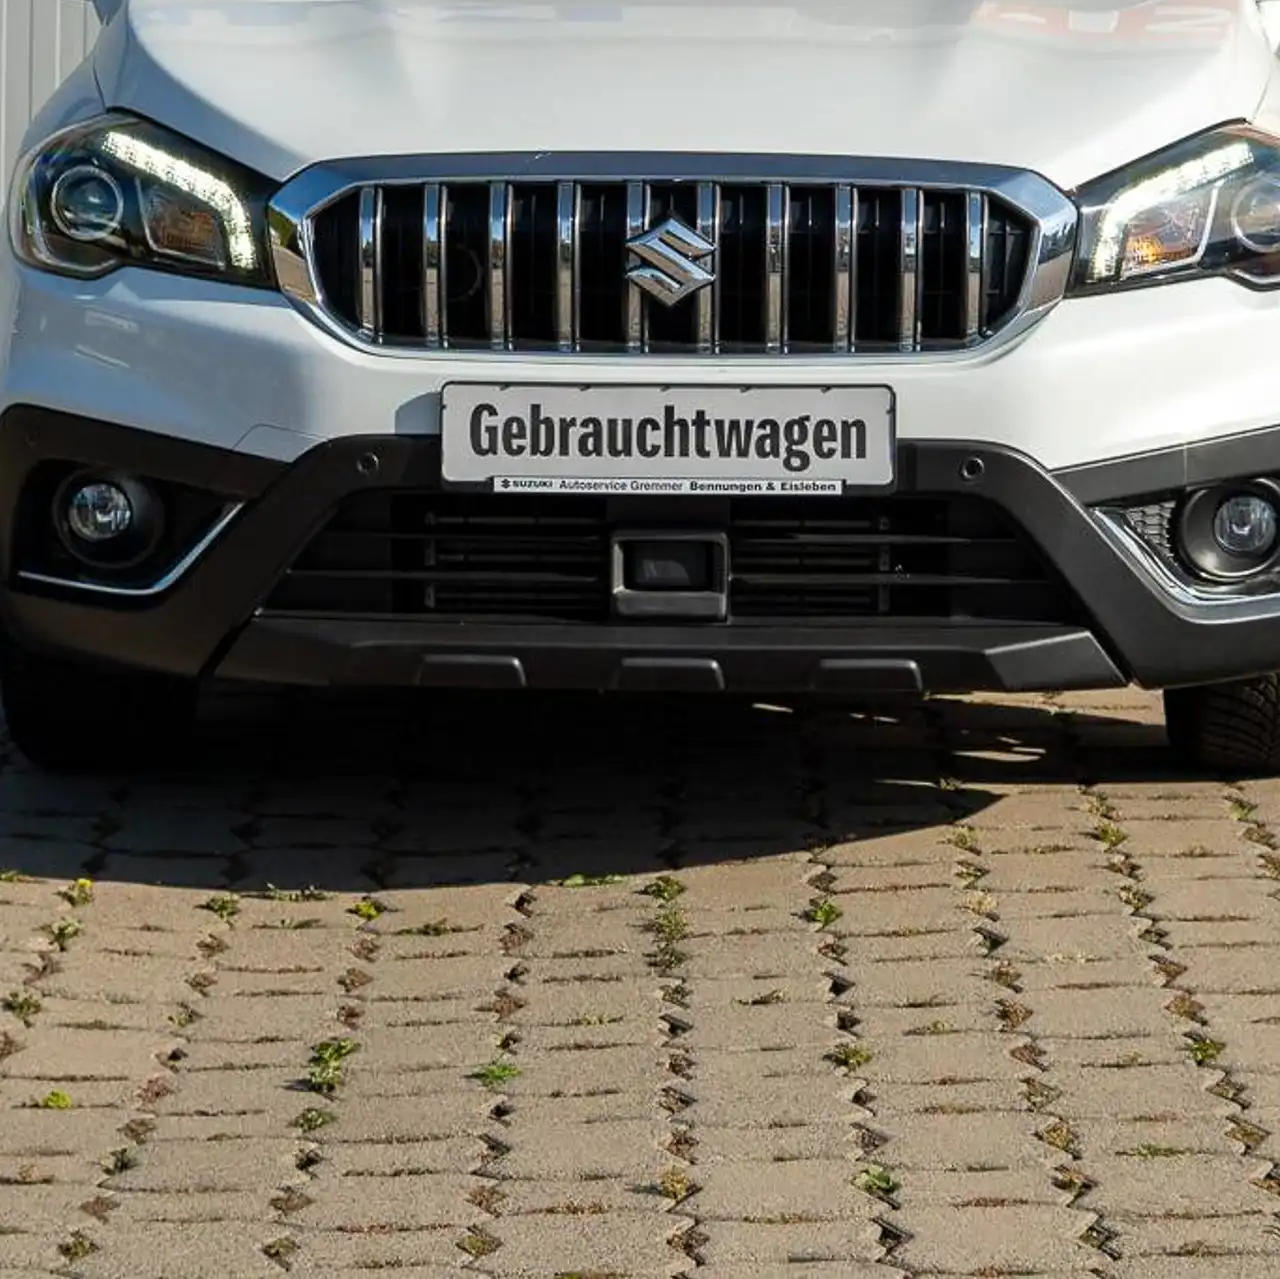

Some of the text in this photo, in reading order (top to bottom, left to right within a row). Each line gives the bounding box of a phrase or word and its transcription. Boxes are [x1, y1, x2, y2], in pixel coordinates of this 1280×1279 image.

[469, 403, 867, 472] Gebrauchtwagen
[512, 480, 554, 489] SUZUKI
[559, 480, 627, 491] Autoservice
[765, 482, 777, 492] &
[780, 482, 836, 492] Eisleben
